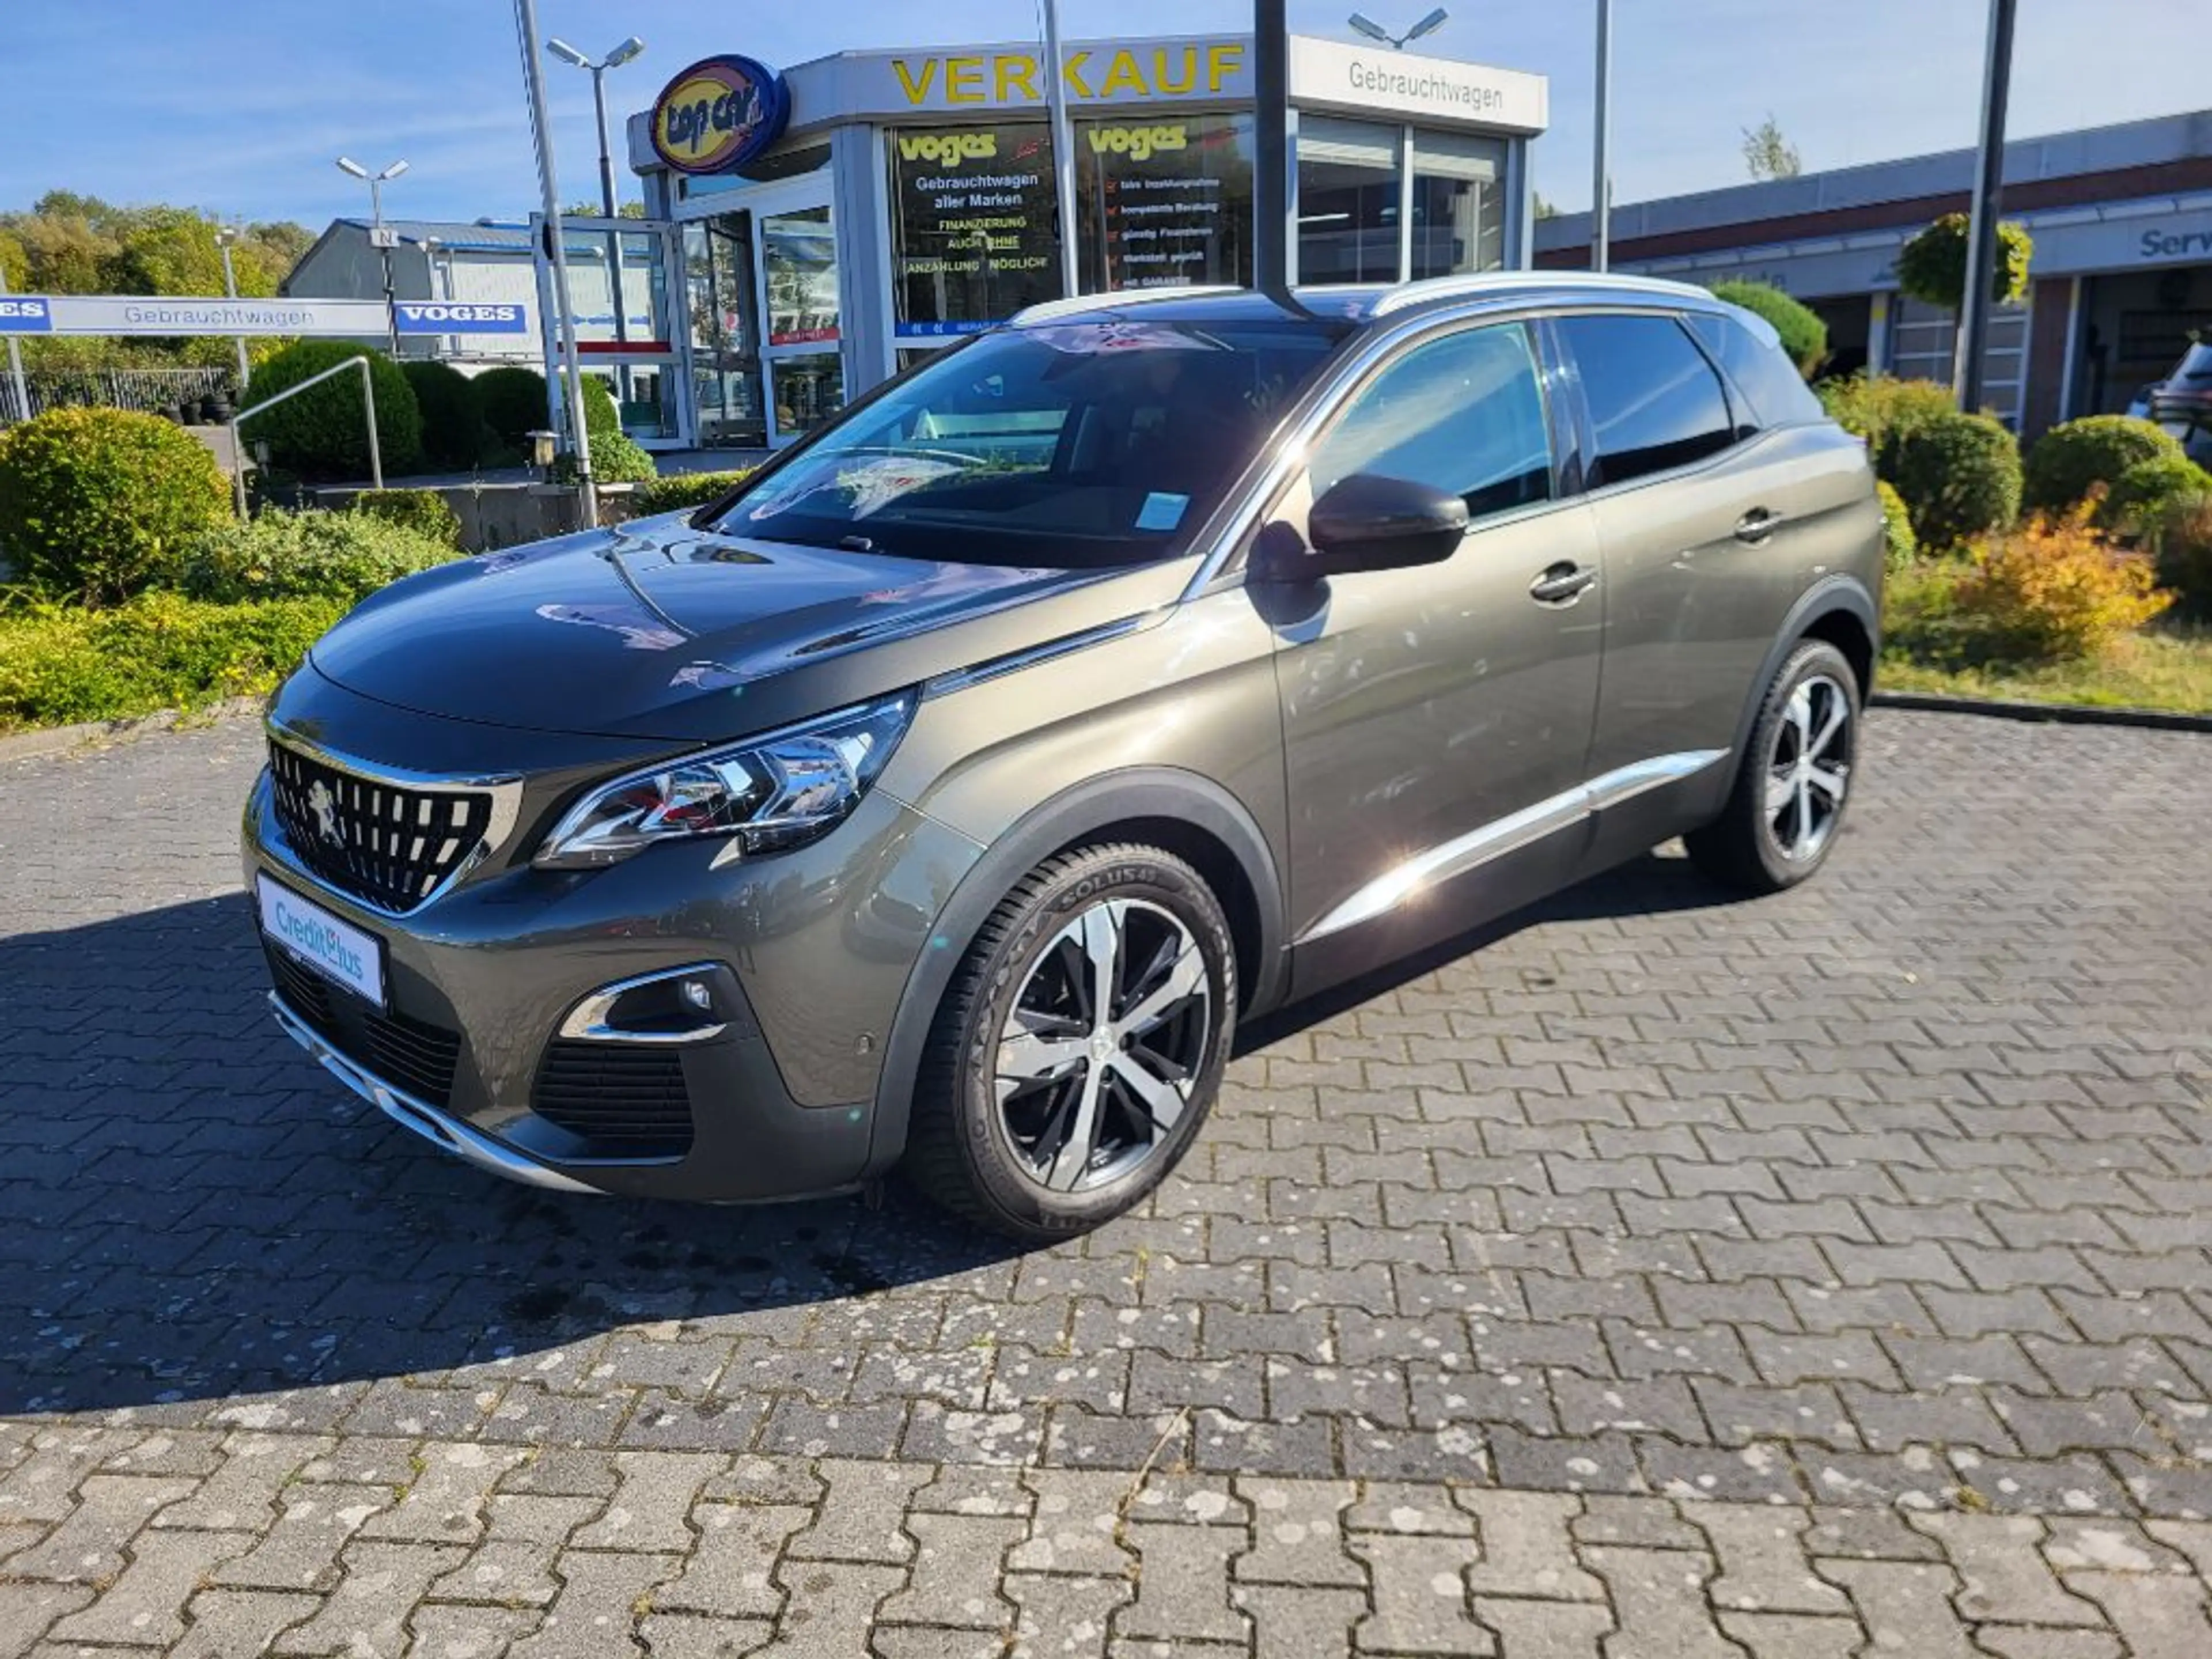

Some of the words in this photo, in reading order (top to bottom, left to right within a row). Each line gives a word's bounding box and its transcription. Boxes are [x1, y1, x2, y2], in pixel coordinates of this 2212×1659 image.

[892, 44, 1245, 105] VERKAUF
[1350, 62, 1503, 111] Gebrauchtwagen
[899, 133, 997, 168] voges
[1088, 124, 1187, 162] voges
[915, 173, 1039, 191] Gebrauchtwagen
[934, 195, 965, 209] aller
[969, 192, 1023, 207] Marken
[938, 215, 1027, 231] FINANZIERUNG
[947, 237, 982, 250] AUCH
[906, 259, 980, 274] ANZAHLUNG
[124, 306, 315, 326] Gebrauchtwagen
[404, 306, 517, 321] VOGES
